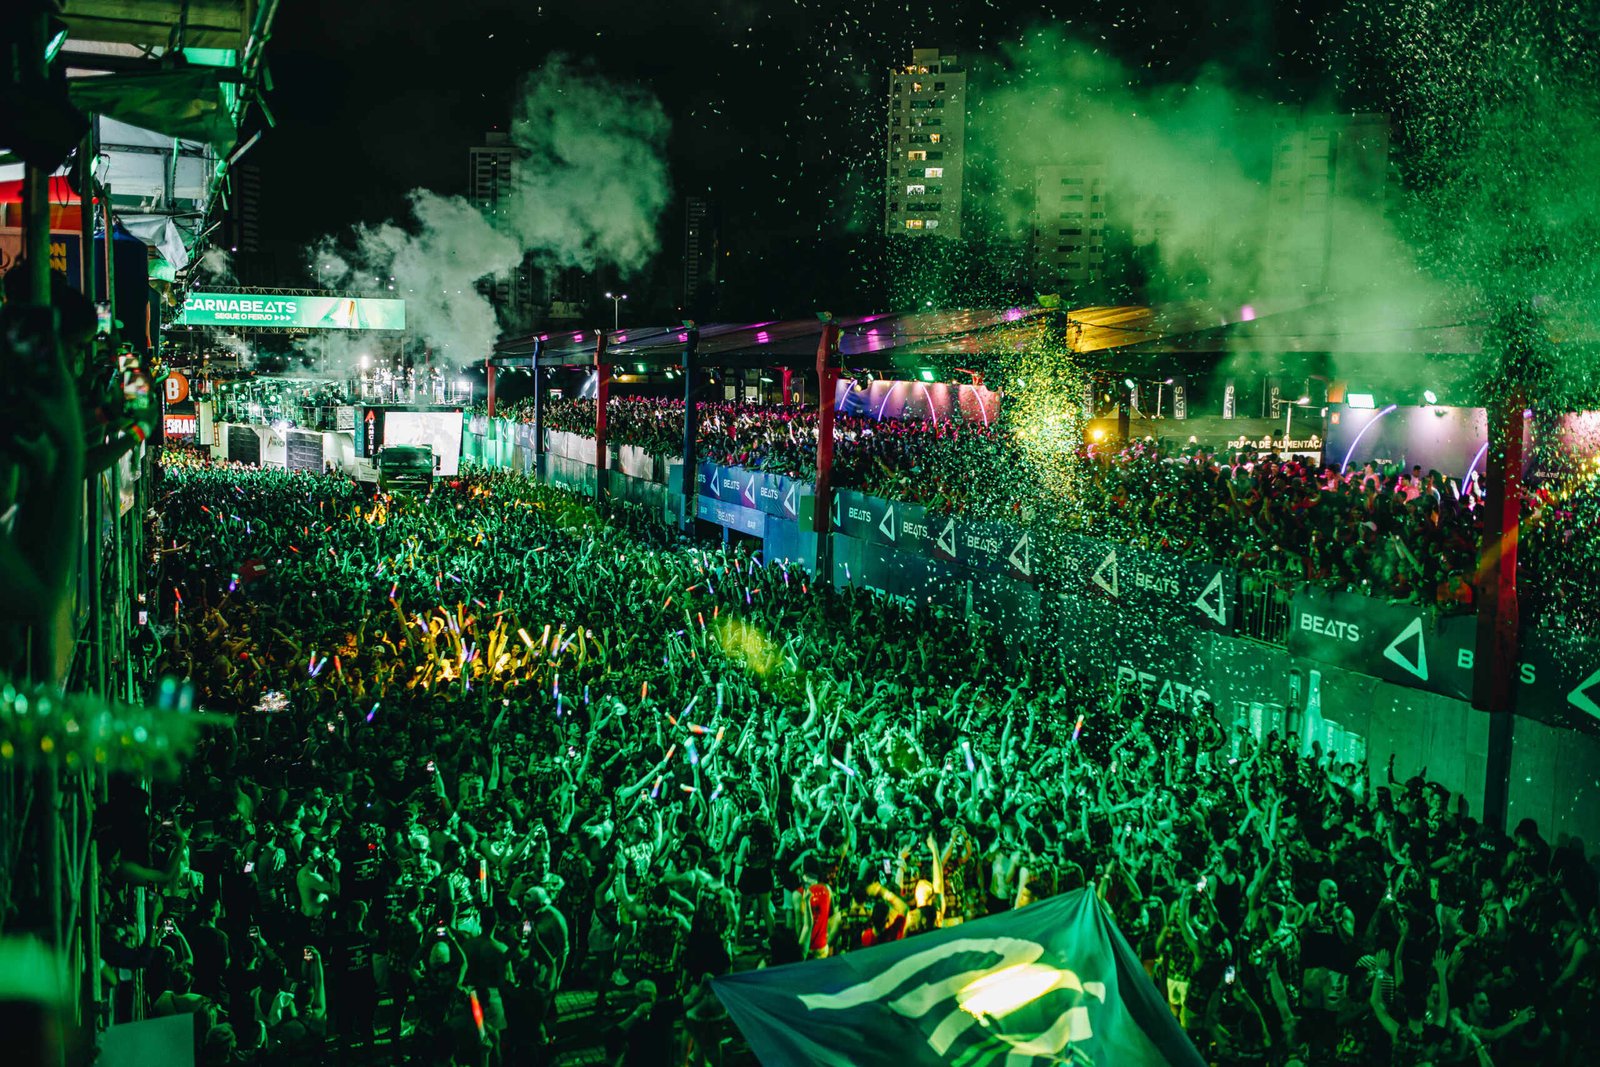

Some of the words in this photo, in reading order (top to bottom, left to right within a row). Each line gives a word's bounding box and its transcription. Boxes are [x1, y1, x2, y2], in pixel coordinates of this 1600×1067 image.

[184, 298, 297, 313] CARNABEATS
[214, 312, 240, 320] SEGUE
[241, 312, 247, 320] O
[247, 313, 273, 321] FERVO
[167, 378, 180, 400] B
[1174, 386, 1184, 419] EATS
[1223, 386, 1235, 420] EATS
[1259, 440, 1271, 449] DE
[723, 478, 741, 490] BEATS
[760, 487, 779, 500] BEATS
[848, 507, 872, 523] BEATS
[902, 521, 928, 538] BEATS
[967, 535, 998, 552] BEATS
[1135, 572, 1181, 595] BEATS
[1300, 612, 1360, 643] BEATS
